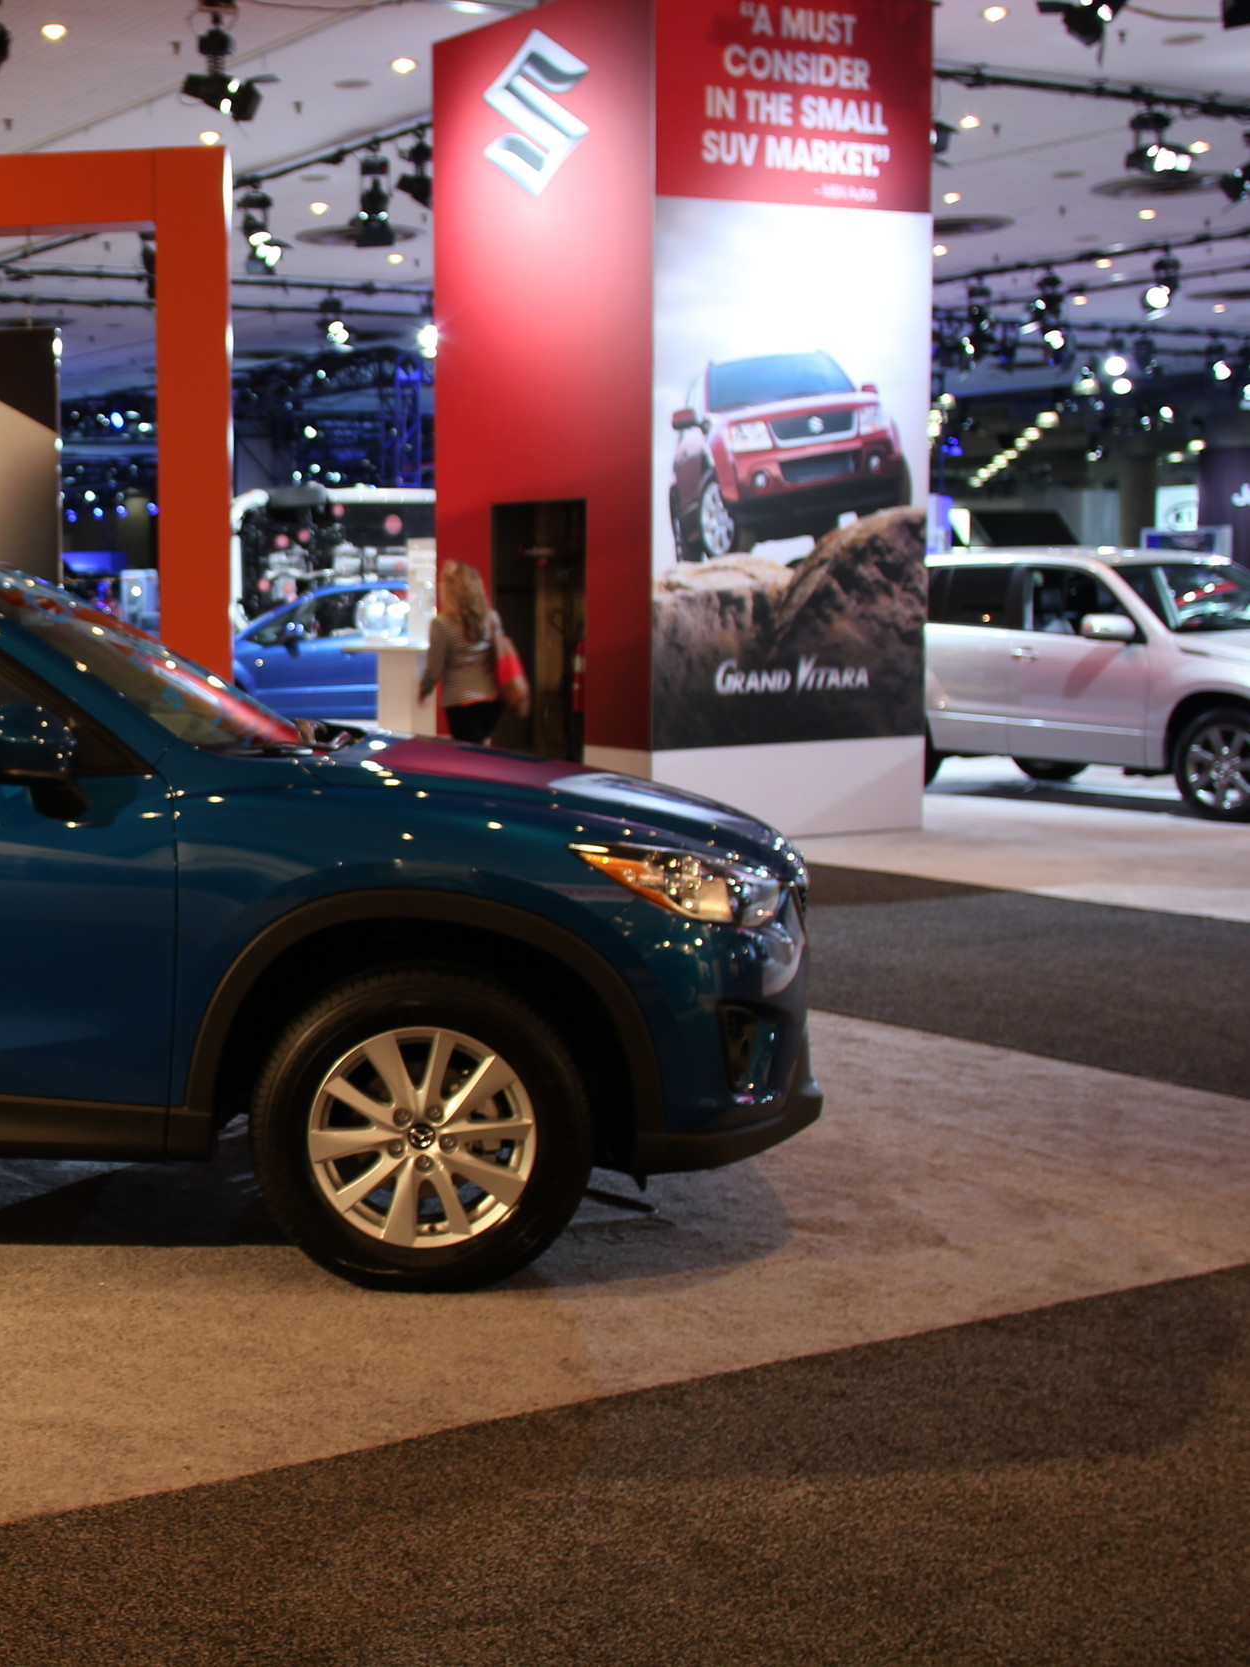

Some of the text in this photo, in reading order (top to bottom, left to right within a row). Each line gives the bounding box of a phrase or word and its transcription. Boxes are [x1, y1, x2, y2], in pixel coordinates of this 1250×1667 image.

[780, 6, 857, 46] MUST
[722, 44, 871, 91] CONSIDER
[704, 85, 889, 136] IN THE SMALL
[701, 129, 759, 167] SUV
[714, 654, 870, 695] GRAND VITARA
